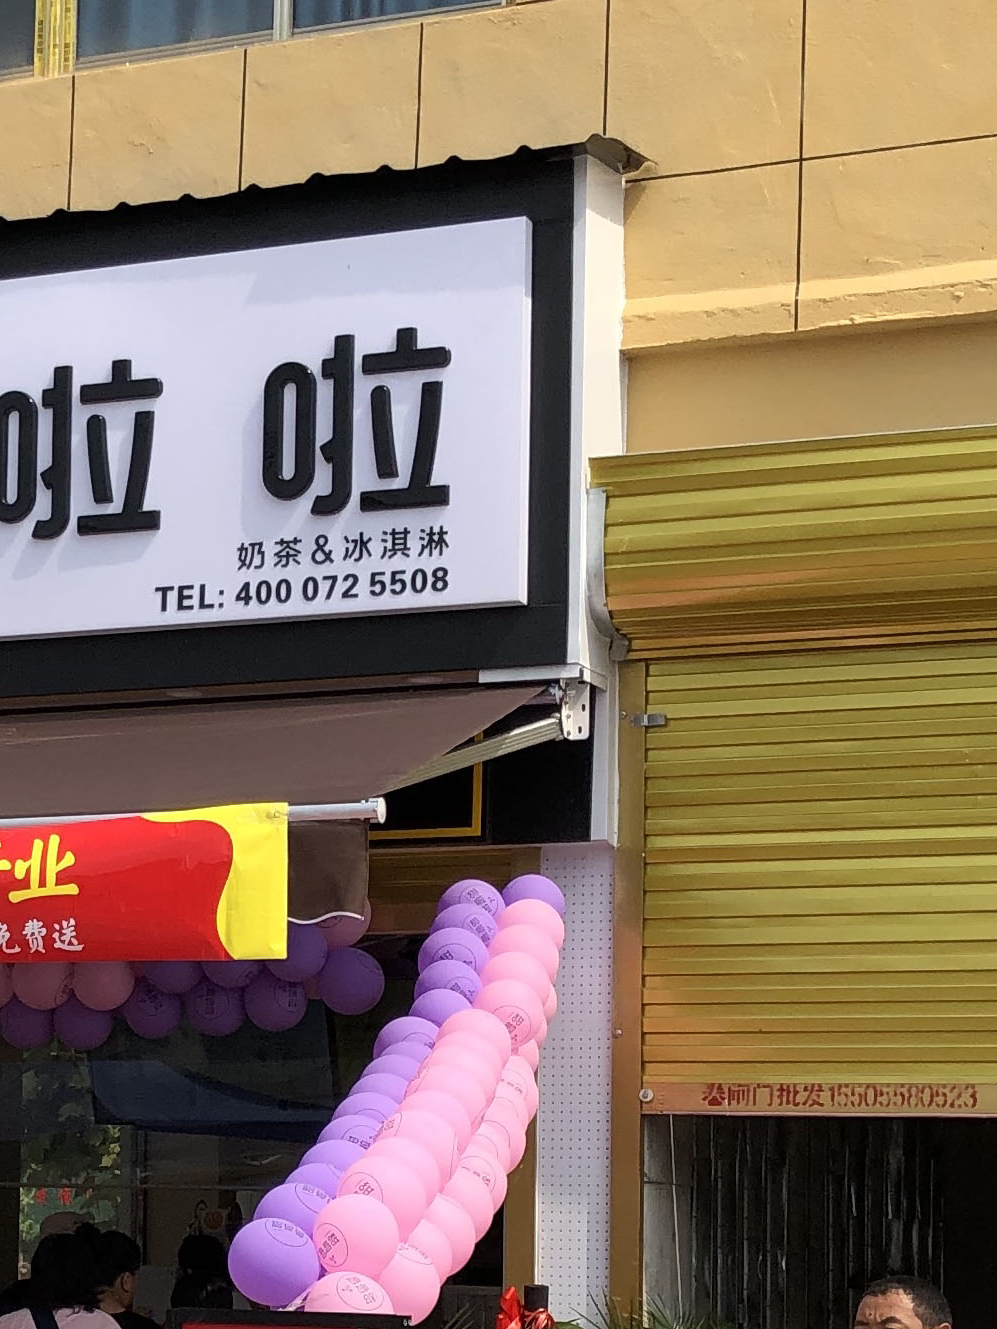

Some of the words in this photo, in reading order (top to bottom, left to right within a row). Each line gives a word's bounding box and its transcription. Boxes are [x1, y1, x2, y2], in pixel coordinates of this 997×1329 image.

[236, 526, 450, 571] 奶茶&冰淇淋
[155, 584, 225, 612] TEL:
[235, 579, 292, 606] 400
[302, 573, 359, 602] 072
[369, 566, 449, 597] 5508
